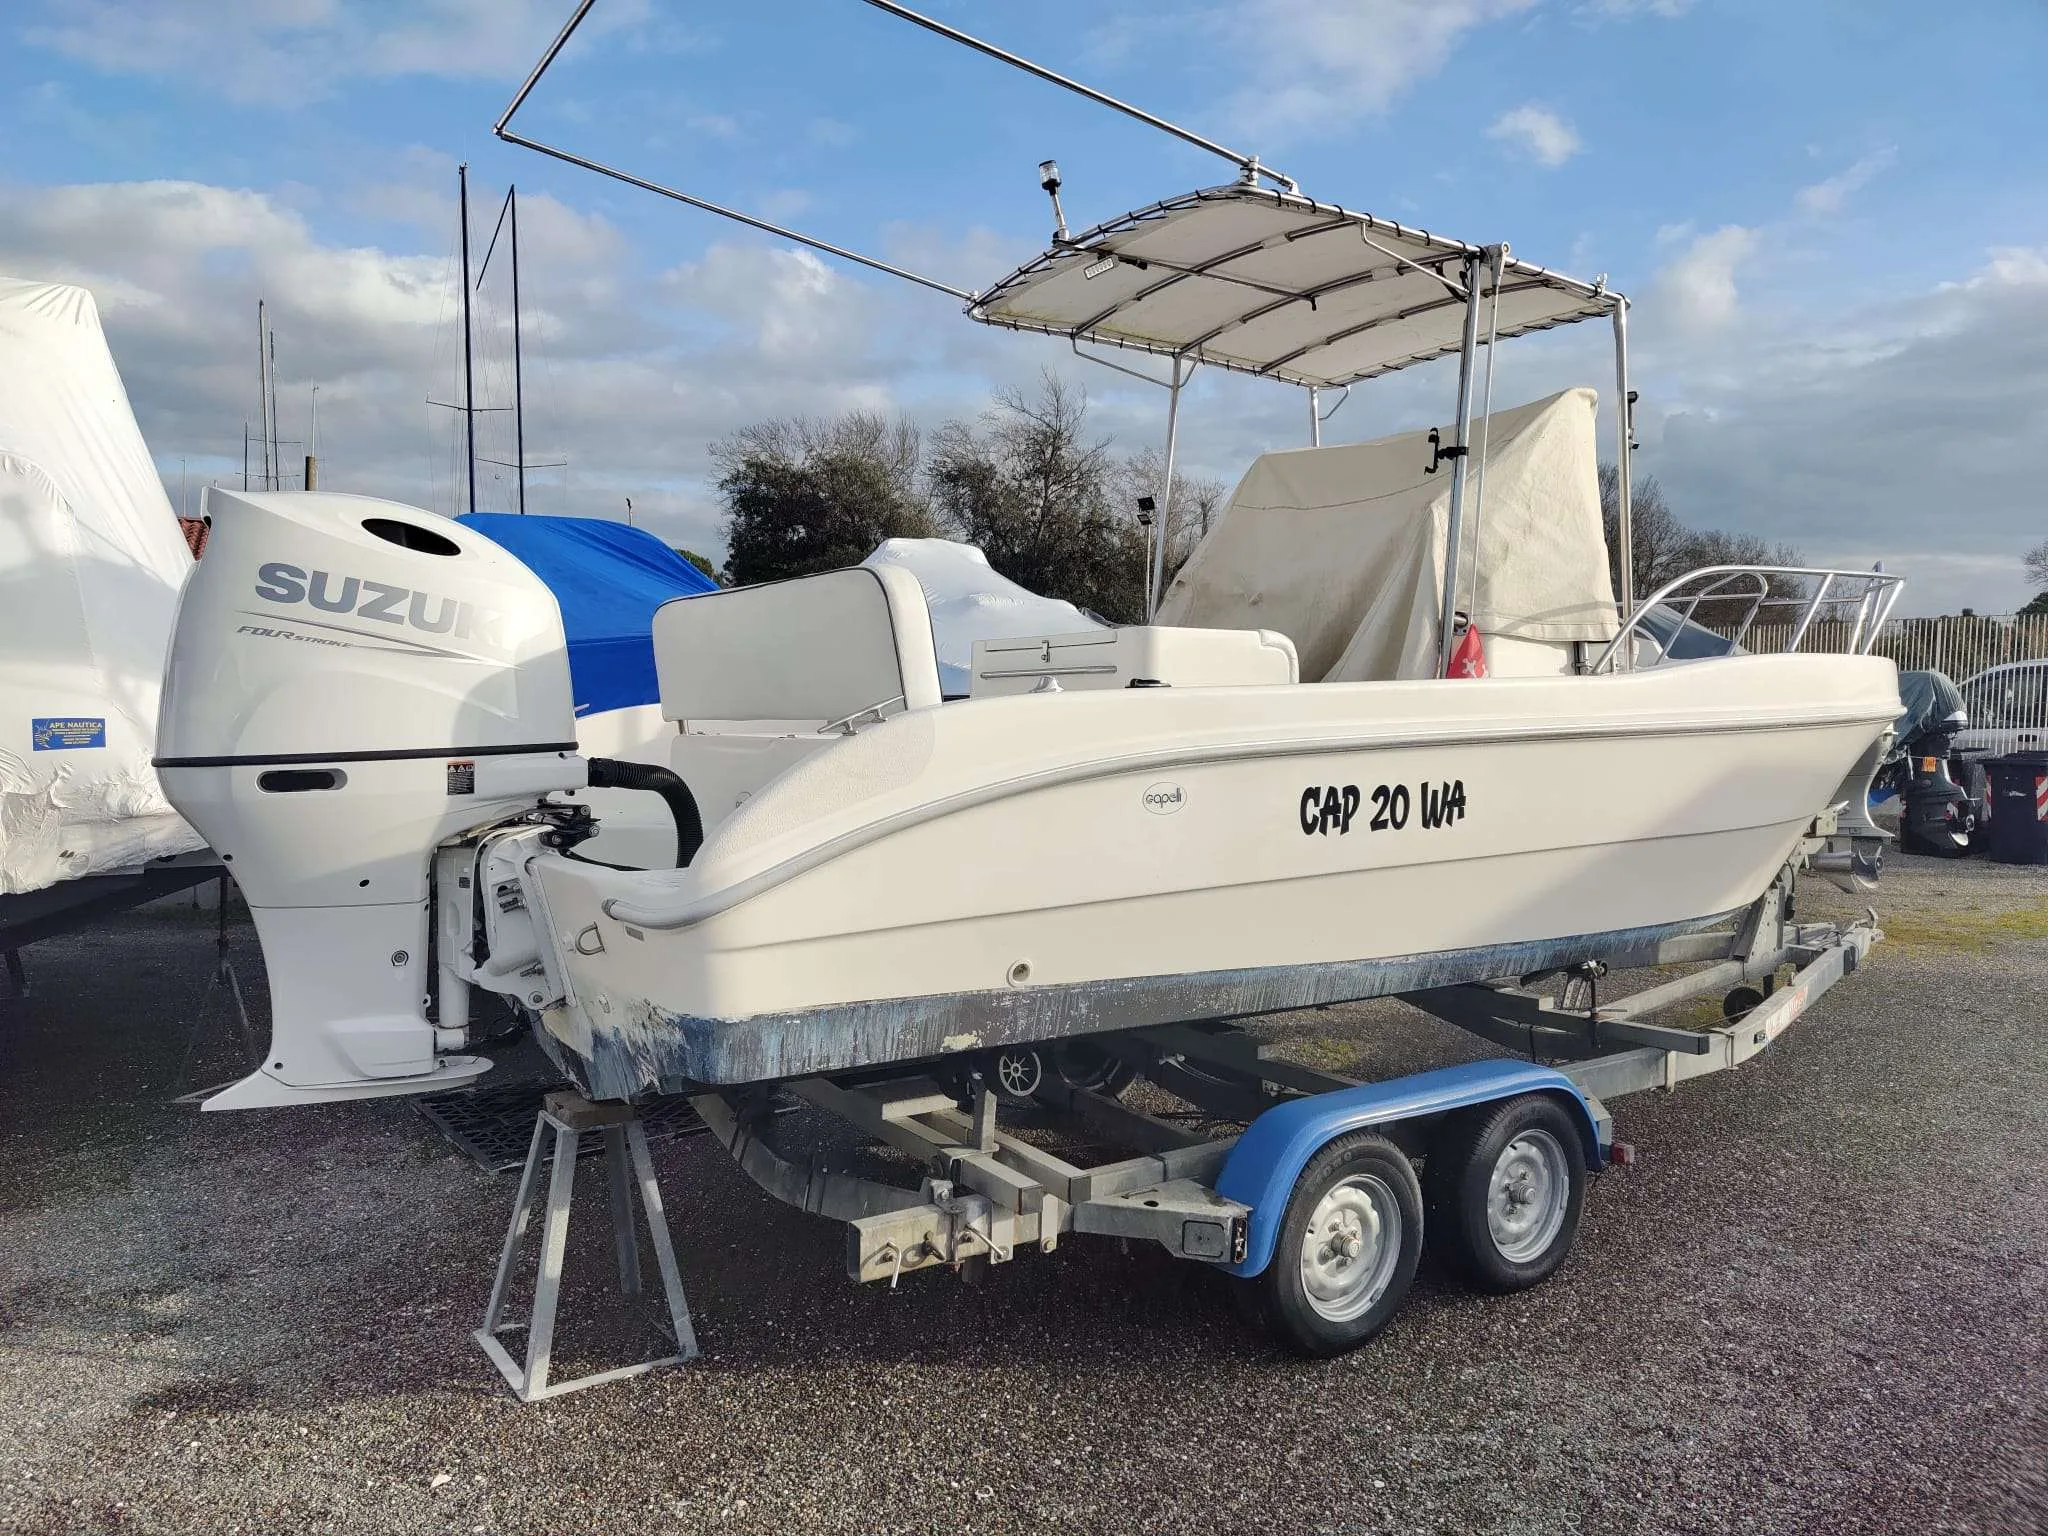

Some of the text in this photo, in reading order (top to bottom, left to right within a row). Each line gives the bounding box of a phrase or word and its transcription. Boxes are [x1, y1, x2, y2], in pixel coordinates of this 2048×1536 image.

[255, 562, 508, 645] SUZUK
[1300, 779, 1467, 837] CAP 20 WA
